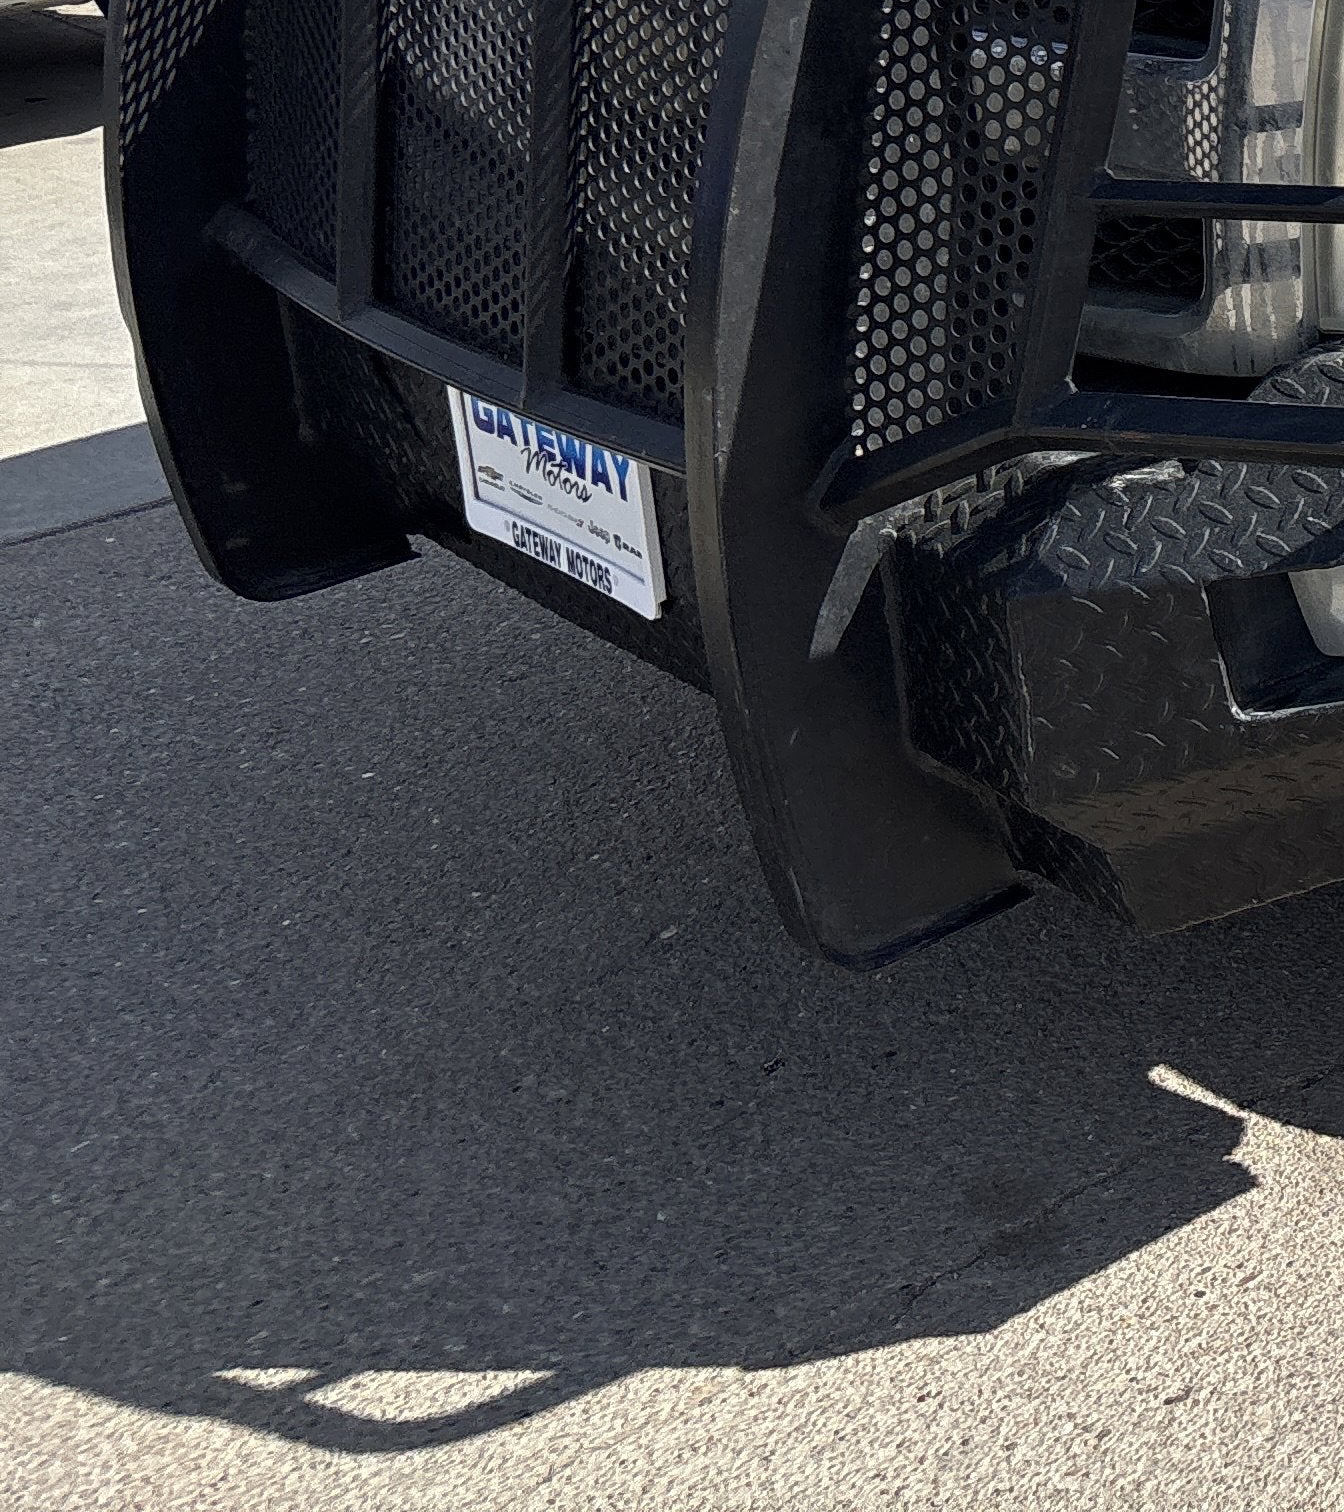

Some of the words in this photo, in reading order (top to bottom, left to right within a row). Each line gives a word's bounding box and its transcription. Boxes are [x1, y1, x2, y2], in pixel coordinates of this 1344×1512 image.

[471, 395, 629, 502] GATEWAY
[521, 447, 592, 503] Motors
[512, 521, 561, 568] GATEWAY
[566, 547, 612, 594] MOTORS
